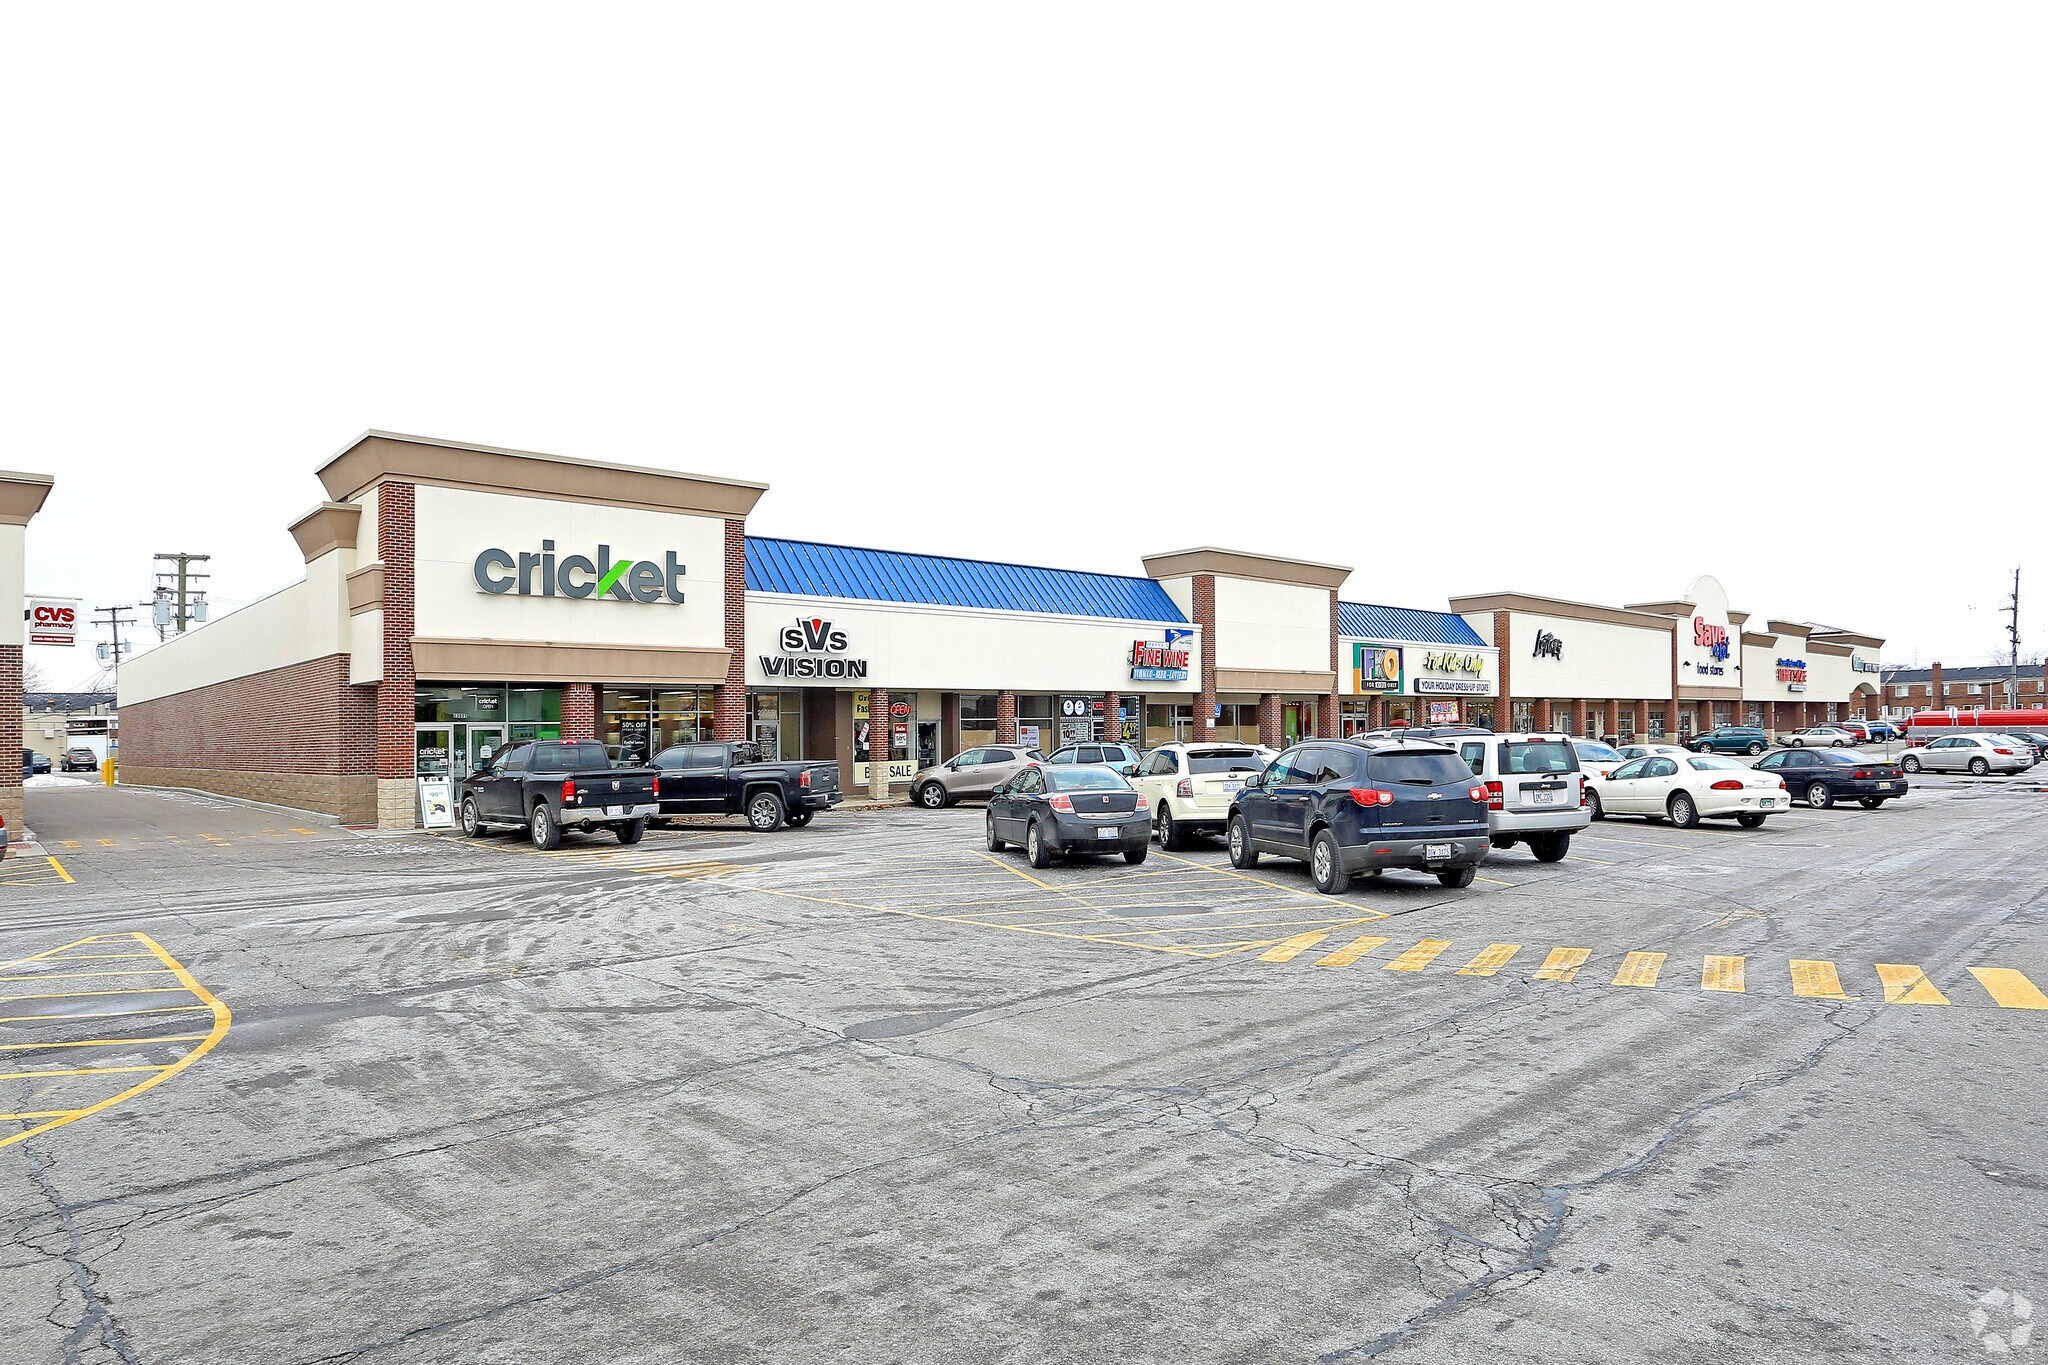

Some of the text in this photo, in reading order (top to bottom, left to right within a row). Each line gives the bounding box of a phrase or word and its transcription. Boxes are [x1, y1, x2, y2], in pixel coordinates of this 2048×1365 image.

[473, 539, 686, 604] cricket
[34, 607, 75, 622] CVS
[1694, 616, 1726, 647] Save
[1162, 649, 1189, 667] WINE
[761, 656, 867, 678] VISION
[1697, 662, 1724, 676] food stores
[1421, 681, 1436, 691] YOUR
[1436, 682, 1455, 691] HOLIDAY
[1476, 684, 1489, 692] STORE
[890, 704, 911, 715] OPEN
[889, 765, 912, 777] SALE
